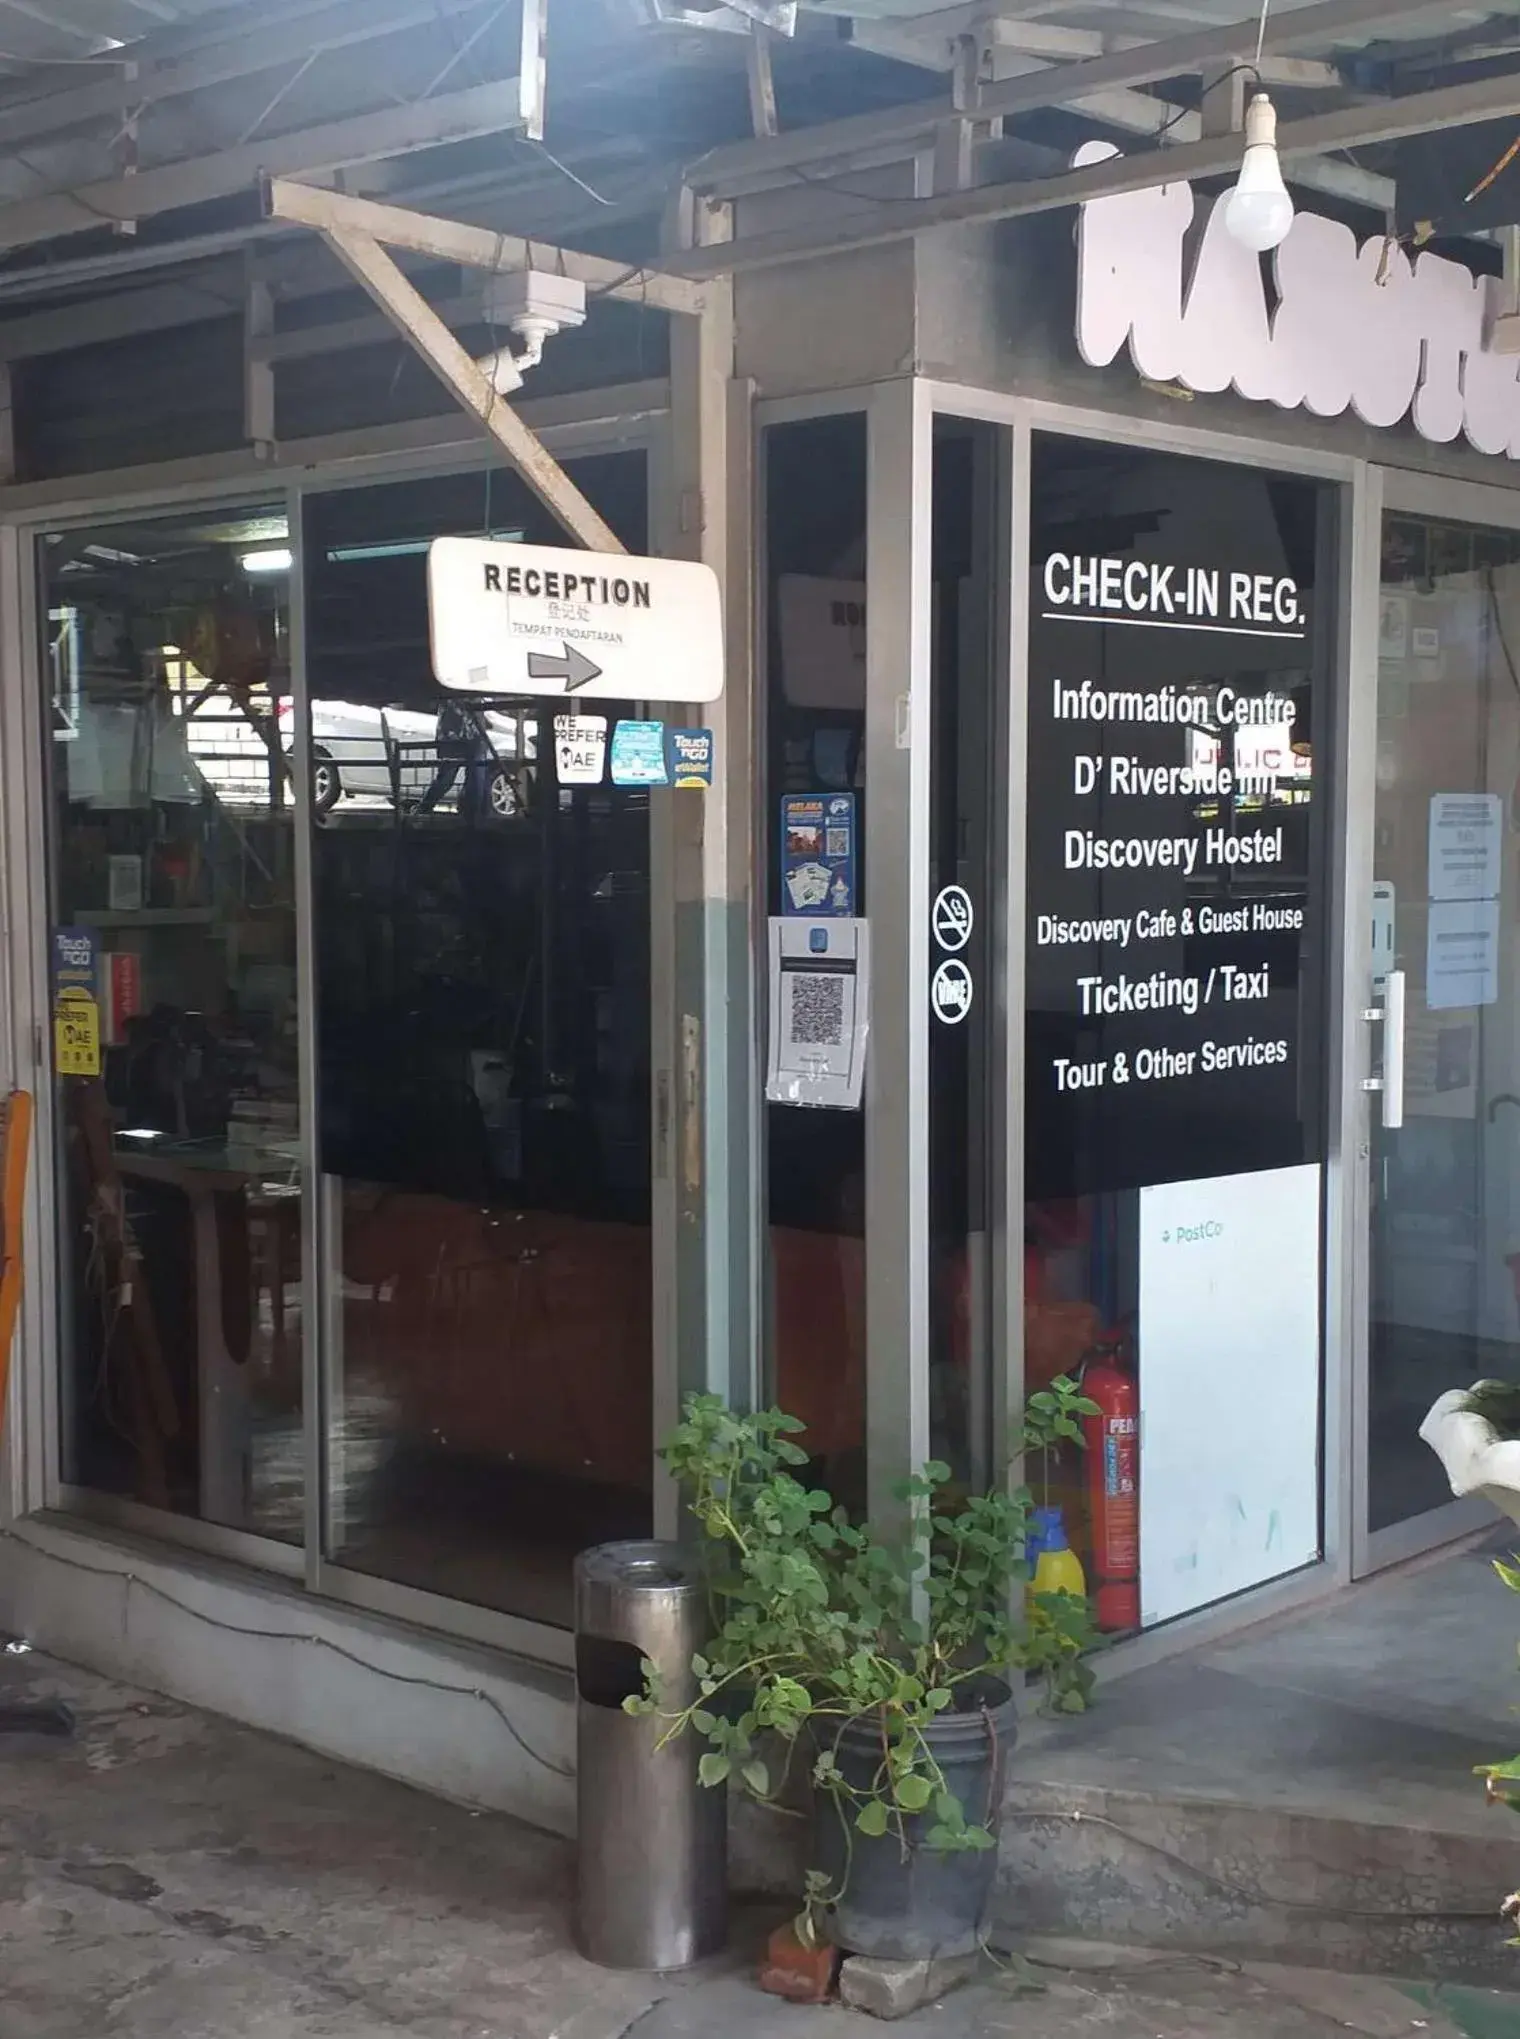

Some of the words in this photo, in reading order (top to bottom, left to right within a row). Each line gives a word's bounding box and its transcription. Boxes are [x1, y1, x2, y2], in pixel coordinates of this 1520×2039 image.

[483, 562, 651, 609] RECEPTION
[1043, 551, 1219, 617] CHECK-IN
[1229, 572, 1306, 625] REG.
[511, 622, 553, 635] TEMPAT
[554, 626, 624, 644] PENDAFTARAN
[1053, 678, 1209, 723] Information
[1215, 686, 1297, 727] Centre
[674, 735, 710, 748] Touch
[1109, 754, 1233, 796] Riverside
[1064, 829, 1199, 875] Discovery
[1205, 826, 1283, 865] Hostel
[56, 935, 92, 950] Touch
[1037, 914, 1132, 948] Discovery
[1135, 908, 1177, 940] Cafe
[1180, 907, 1195, 936] &
[1198, 904, 1250, 935] Guest
[1252, 903, 1304, 931] House
[1075, 970, 1200, 1016] Ticketing
[1203, 967, 1216, 1004] /
[1219, 962, 1270, 1002] Taxi
[1053, 1058, 1107, 1092] Tour
[1111, 1051, 1131, 1084] &
[1135, 1047, 1198, 1081] Other
[1200, 1036, 1289, 1073] Services
